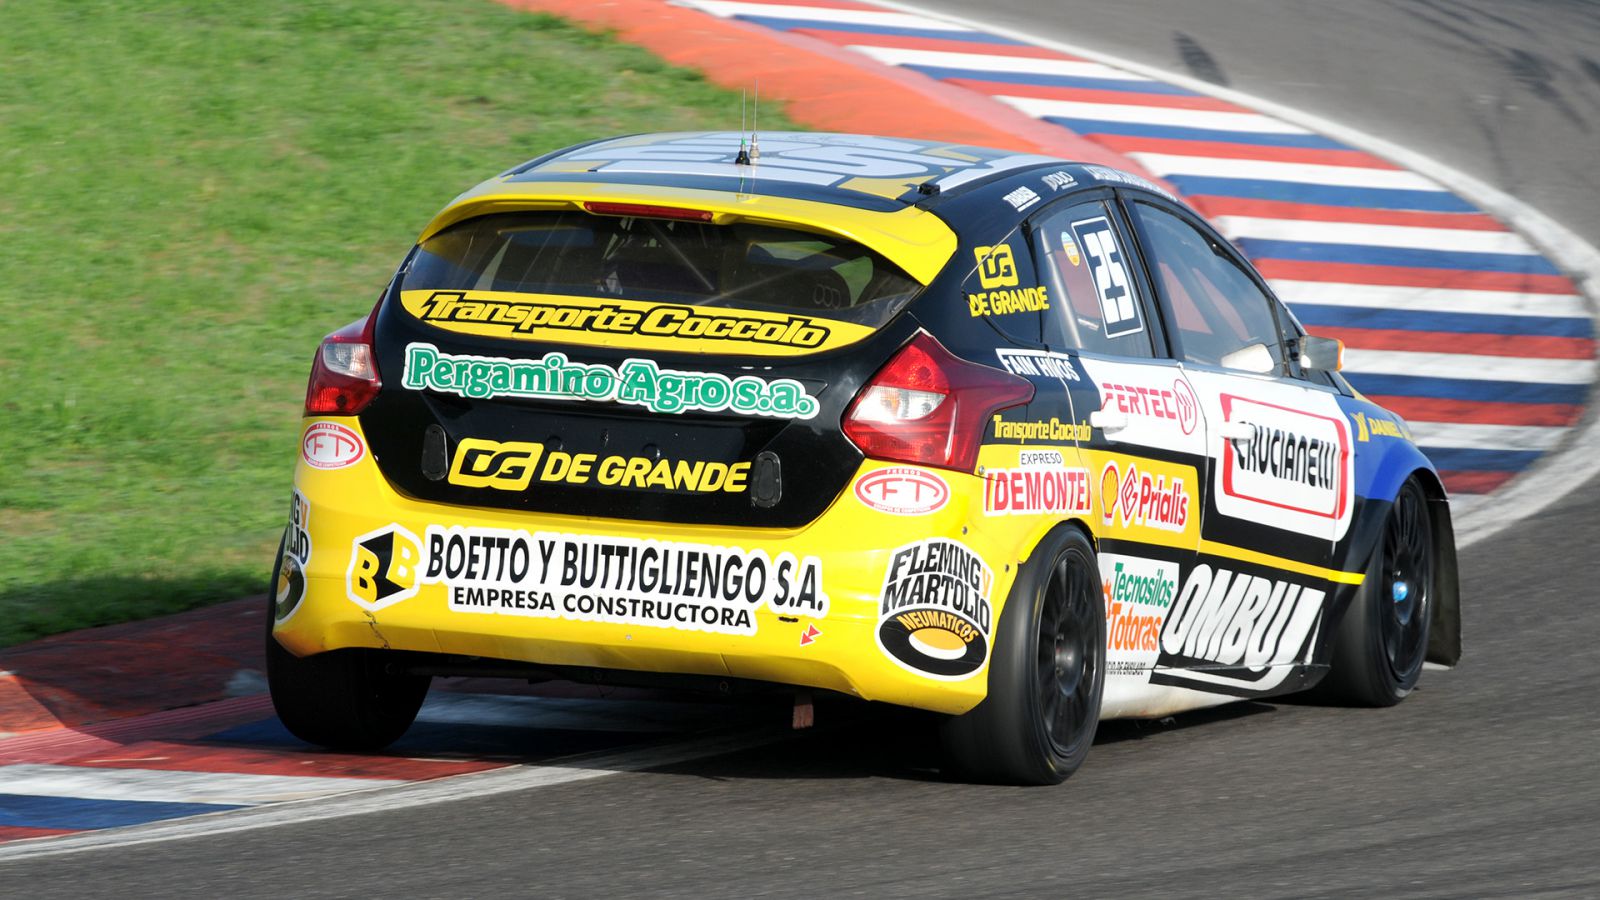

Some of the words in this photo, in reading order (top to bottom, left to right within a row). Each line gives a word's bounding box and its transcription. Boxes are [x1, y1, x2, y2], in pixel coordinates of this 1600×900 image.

[1083, 229, 1135, 324] 25
[420, 292, 641, 334] Transporte
[640, 303, 831, 347] Coccolo
[968, 294, 990, 317] DE
[989, 286, 1050, 316] GRANDE
[405, 344, 616, 399] Pergamino
[619, 360, 731, 413] Agro
[733, 376, 819, 419] s.a.
[1101, 383, 1177, 419] FERTEC
[993, 414, 1049, 444] Transporte
[1049, 417, 1091, 441] Coccolo
[541, 451, 596, 483] DE
[597, 456, 751, 492] GRANDE
[1021, 453, 1062, 465] EXPRESO
[1138, 476, 1188, 526] Prialis
[426, 533, 532, 583] BOETTO
[538, 539, 557, 584] Y
[561, 544, 766, 602] BUTTIGLIENGO
[773, 560, 824, 611] S.A.
[888, 542, 981, 591] FLEMING
[1112, 562, 1174, 608] Tecnosilos
[454, 587, 555, 610] EMPRESA
[563, 594, 750, 628] CONSTRUCTORA
[882, 574, 990, 635] MARTOLIO
[897, 610, 979, 643] NEUMATICOS
[1107, 602, 1162, 652] Totoras
